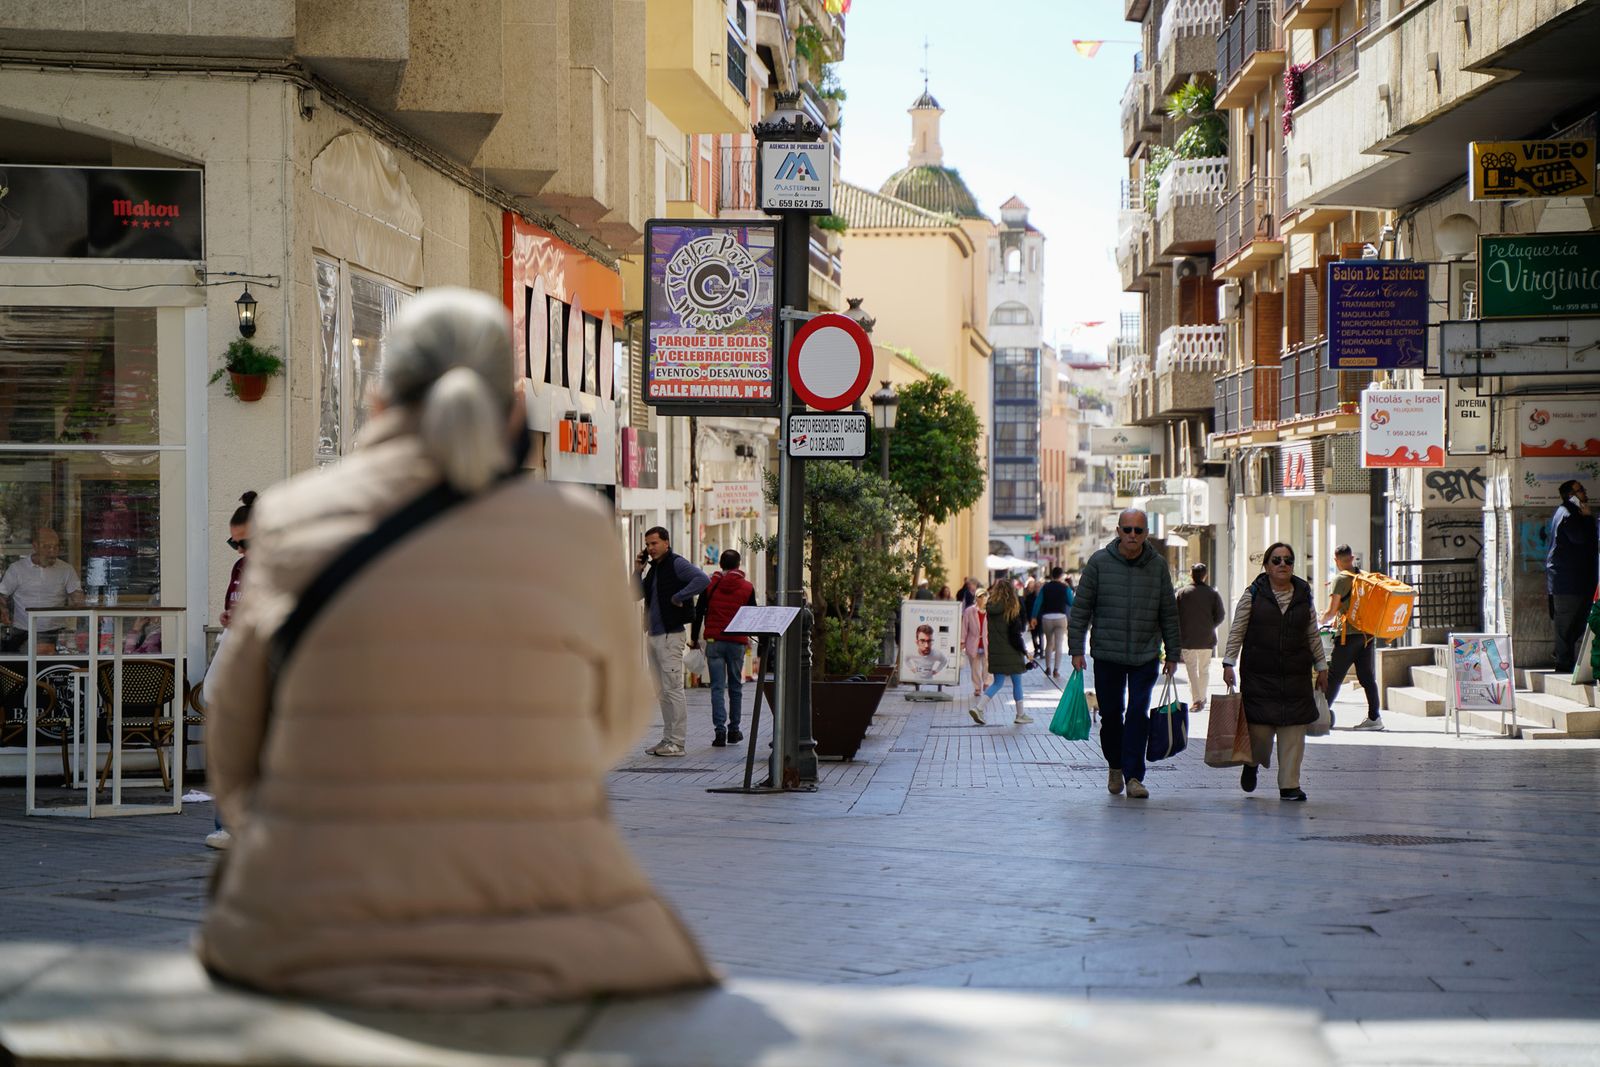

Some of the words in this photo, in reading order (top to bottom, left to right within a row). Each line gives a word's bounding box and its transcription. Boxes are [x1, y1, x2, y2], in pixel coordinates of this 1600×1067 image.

[112, 199, 181, 217] Mahou
[779, 200, 793, 208] 659
[794, 200, 808, 208] 624
[811, 200, 824, 208] 735
[668, 241, 714, 276] Coffee
[718, 233, 755, 276] Park
[1333, 267, 1364, 280] Salón
[1366, 267, 1380, 280] De
[1382, 266, 1425, 280] Estética
[1341, 283, 1377, 298] Luisa
[1341, 301, 1396, 309] TRATAMIENTOS
[675, 297, 744, 329] Marina
[1341, 319, 1419, 328] MICROPIGMENTACION
[1341, 329, 1384, 337] DEPILACION
[658, 336, 706, 348] PARQUE
[708, 336, 725, 347] DE
[727, 336, 767, 348] BOLAS
[657, 350, 666, 361] Y
[668, 350, 767, 362] CELEBRACIONES
[656, 368, 700, 378] EVENTOS
[709, 368, 768, 379] DESAYUNOS
[650, 384, 689, 396] CALLE
[690, 384, 743, 398] MARINA,
[1414, 394, 1441, 403] Israel
[1455, 399, 1487, 408] JOYERIA
[1461, 410, 1481, 418] GIL
[791, 418, 812, 433] EXCEPTO
[812, 418, 840, 433] RESIDENTES
[840, 418, 844, 433] Y
[844, 418, 866, 433] GARAJES
[819, 437, 825, 451] DE
[825, 437, 845, 451] AGOSTO
